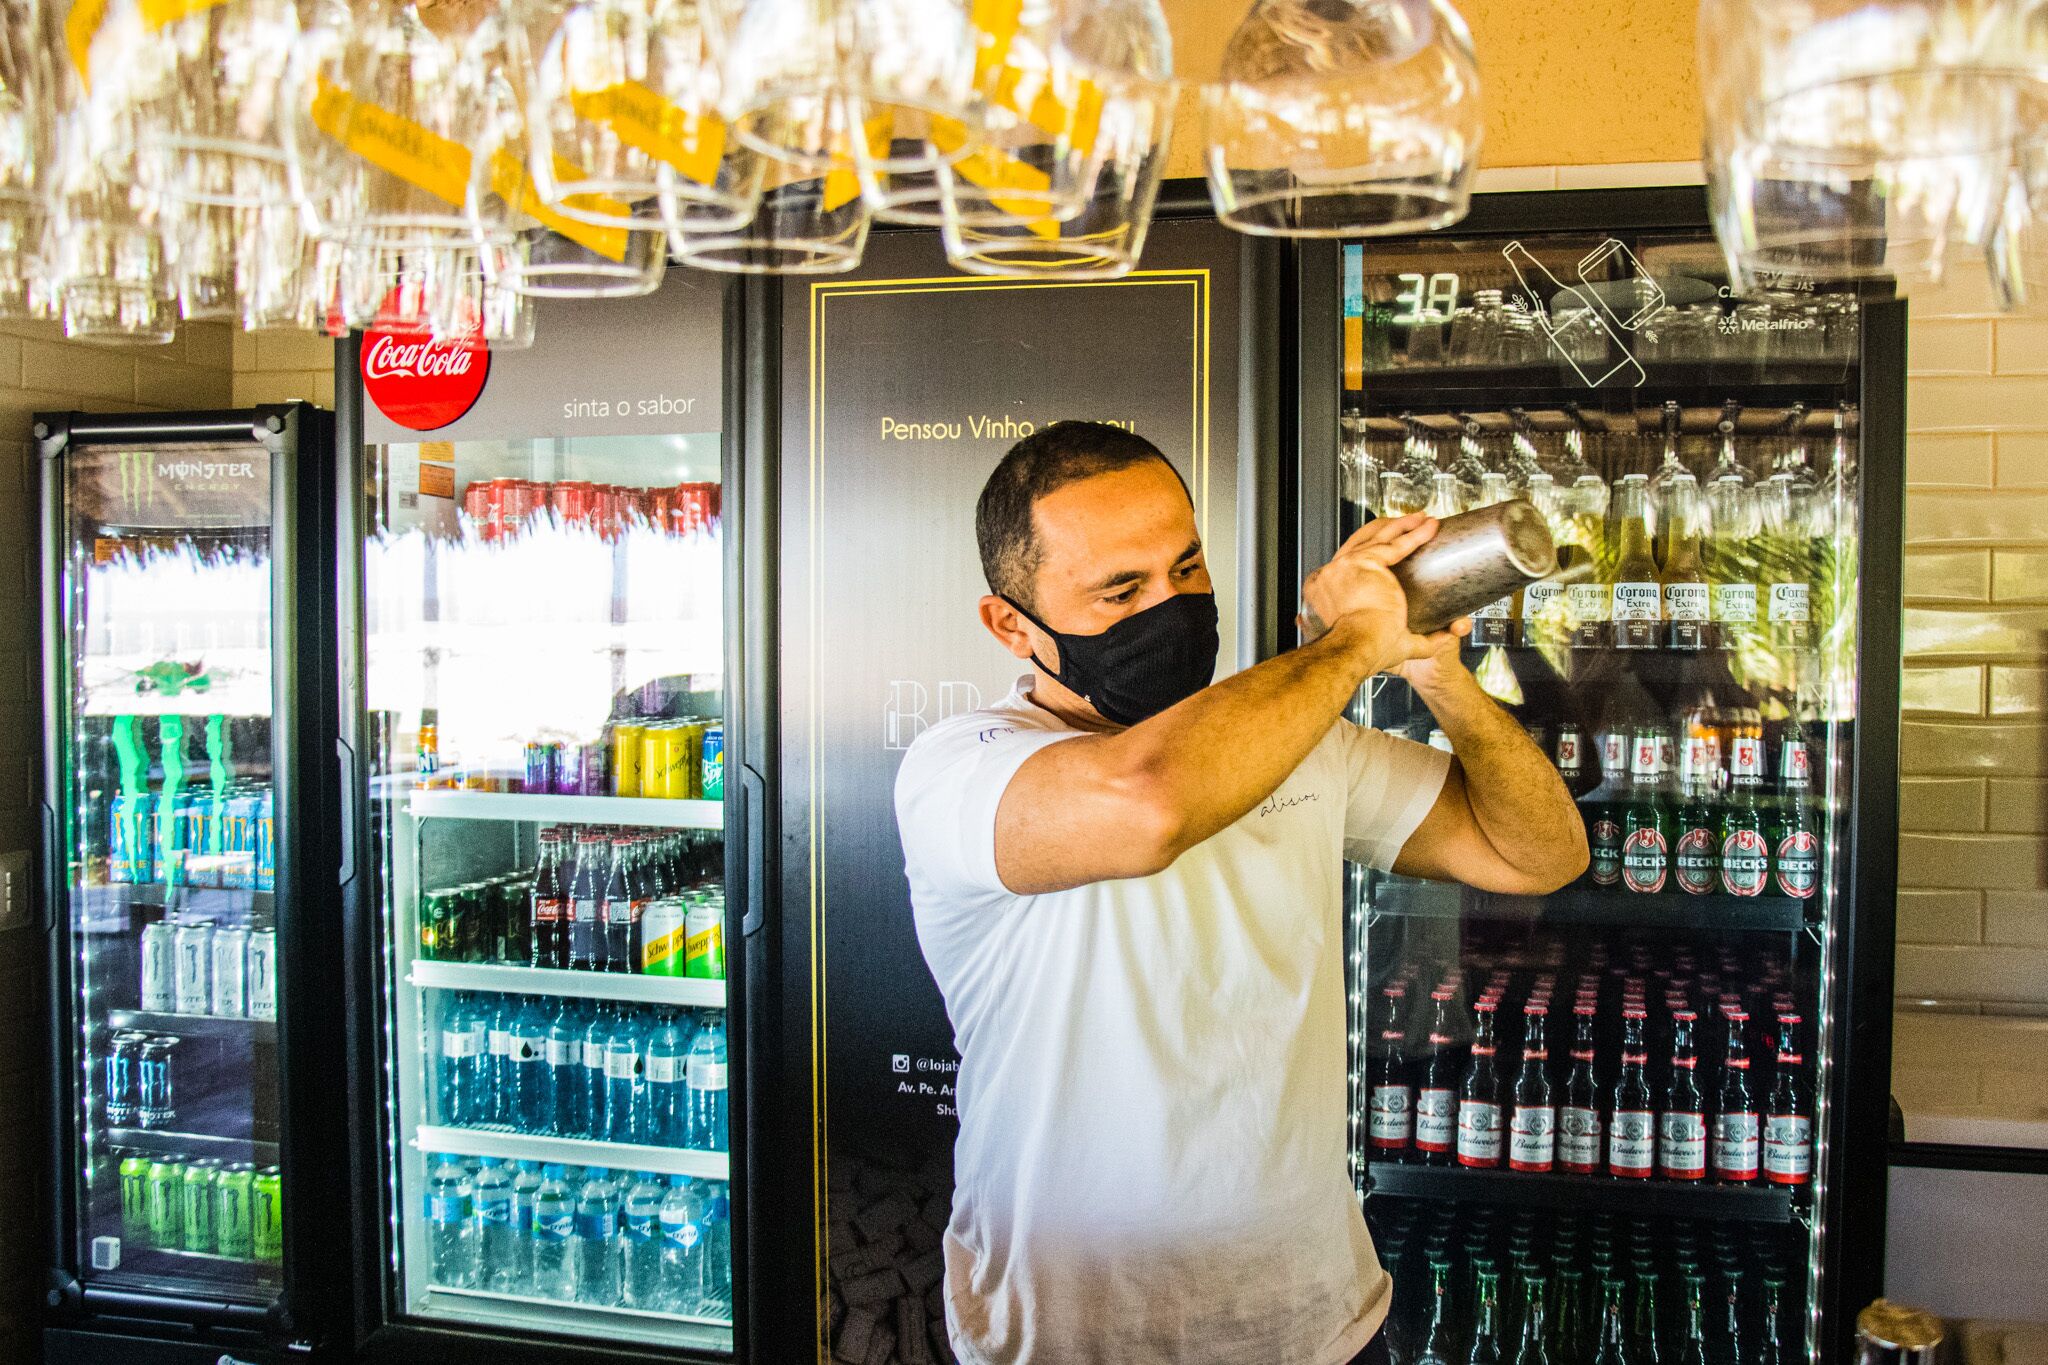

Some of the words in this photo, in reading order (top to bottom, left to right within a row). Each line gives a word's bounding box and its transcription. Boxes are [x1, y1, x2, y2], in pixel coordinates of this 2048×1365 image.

[1741, 319, 1809, 331] Metalfrio
[366, 335, 473, 379] Coca-Cola
[563, 398, 610, 418] sinta
[617, 401, 631, 416] o
[638, 394, 696, 415] sabor
[881, 416, 961, 440] Pensou
[158, 461, 255, 480] MONSTER
[1616, 586, 1657, 600] Corona
[1664, 586, 1706, 600] Corona
[1626, 599, 1650, 608] Extra
[1624, 855, 1668, 867] BECK'S
[1723, 857, 1768, 869] BECK'S
[898, 1081, 916, 1093] Av.
[919, 1083, 937, 1095] Pe.
